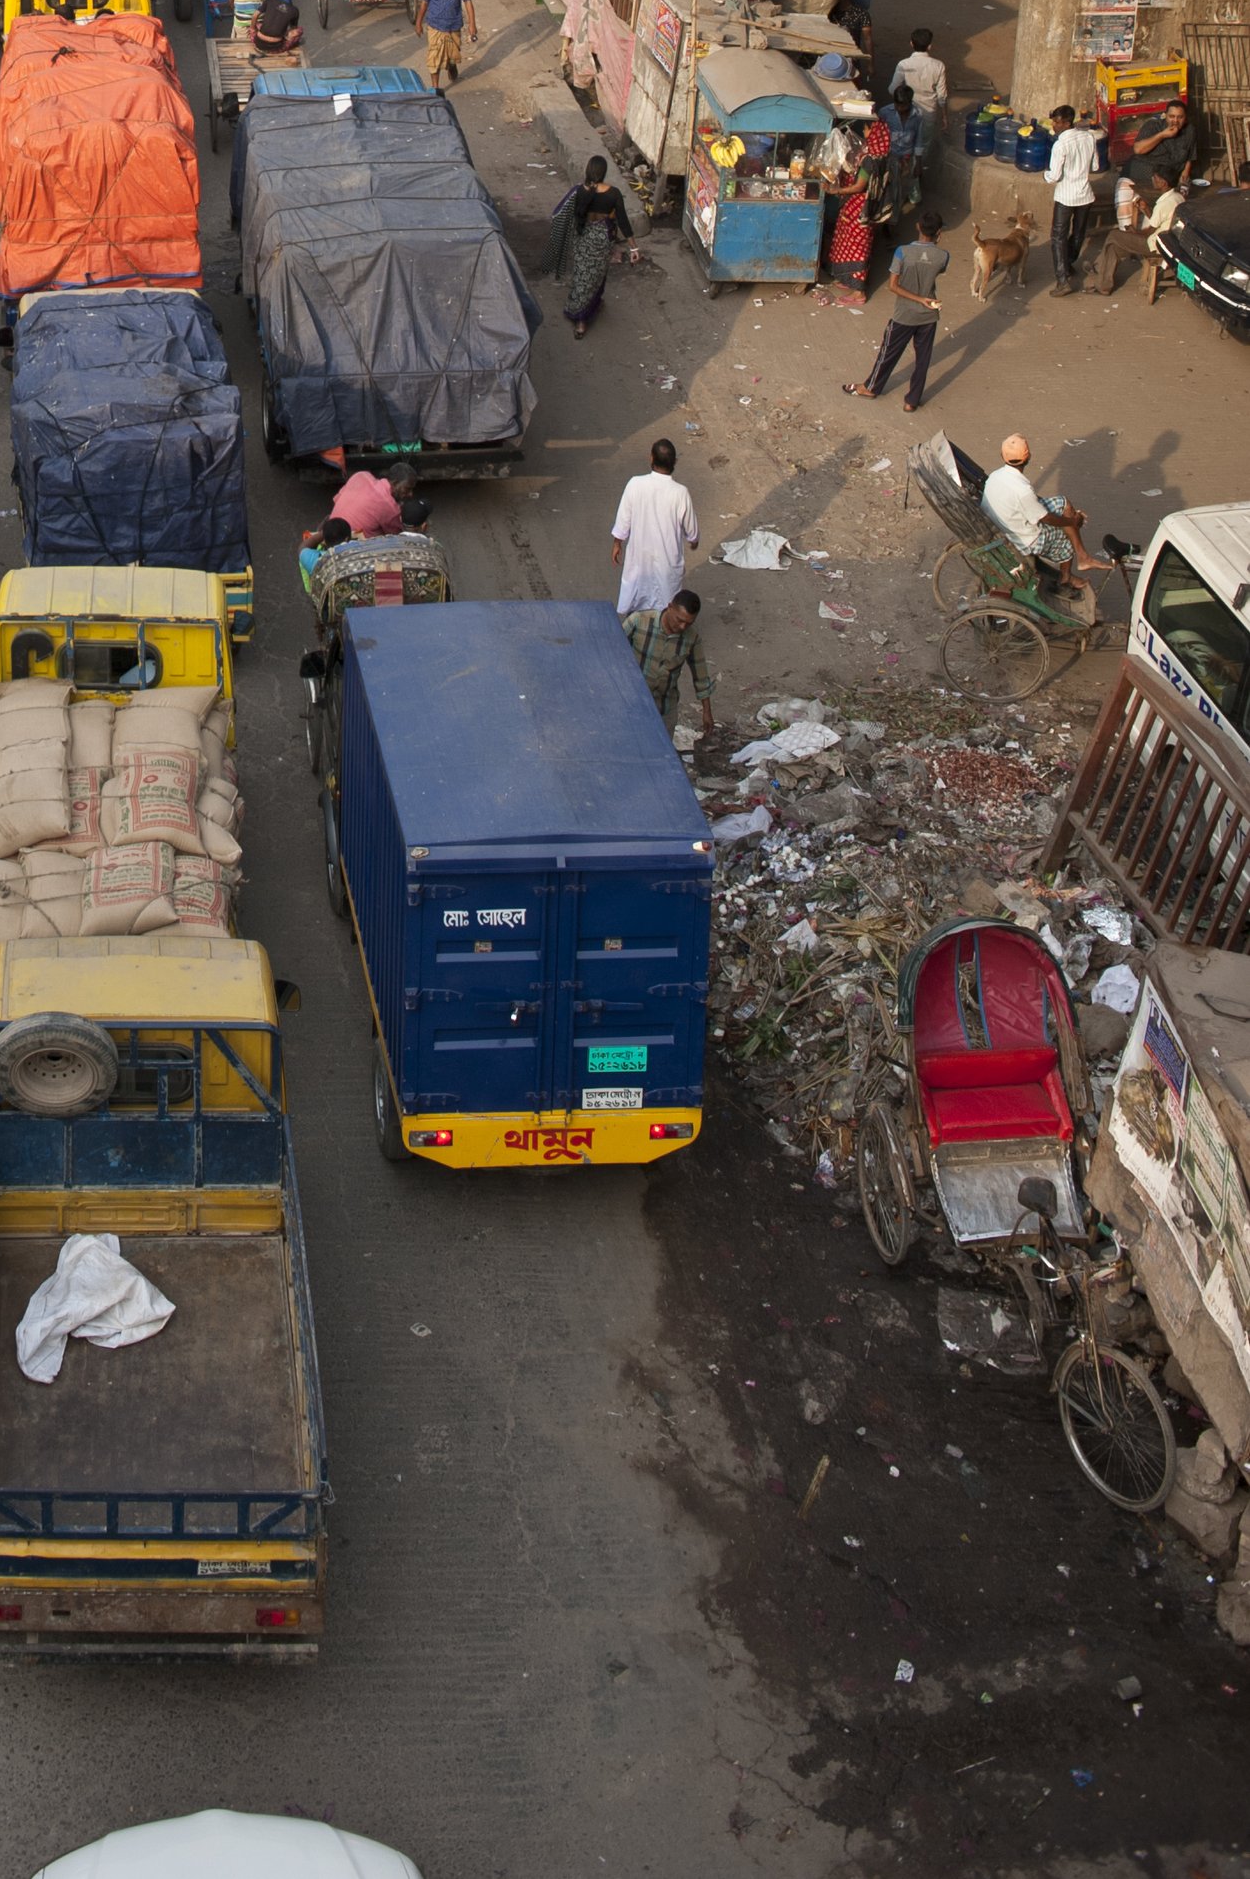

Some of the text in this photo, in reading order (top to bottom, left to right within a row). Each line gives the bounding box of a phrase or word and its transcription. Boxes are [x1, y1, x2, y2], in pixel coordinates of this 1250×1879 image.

[443, 908, 527, 928] মোঃ সোহেল
[504, 1127, 596, 1161] থামুন
